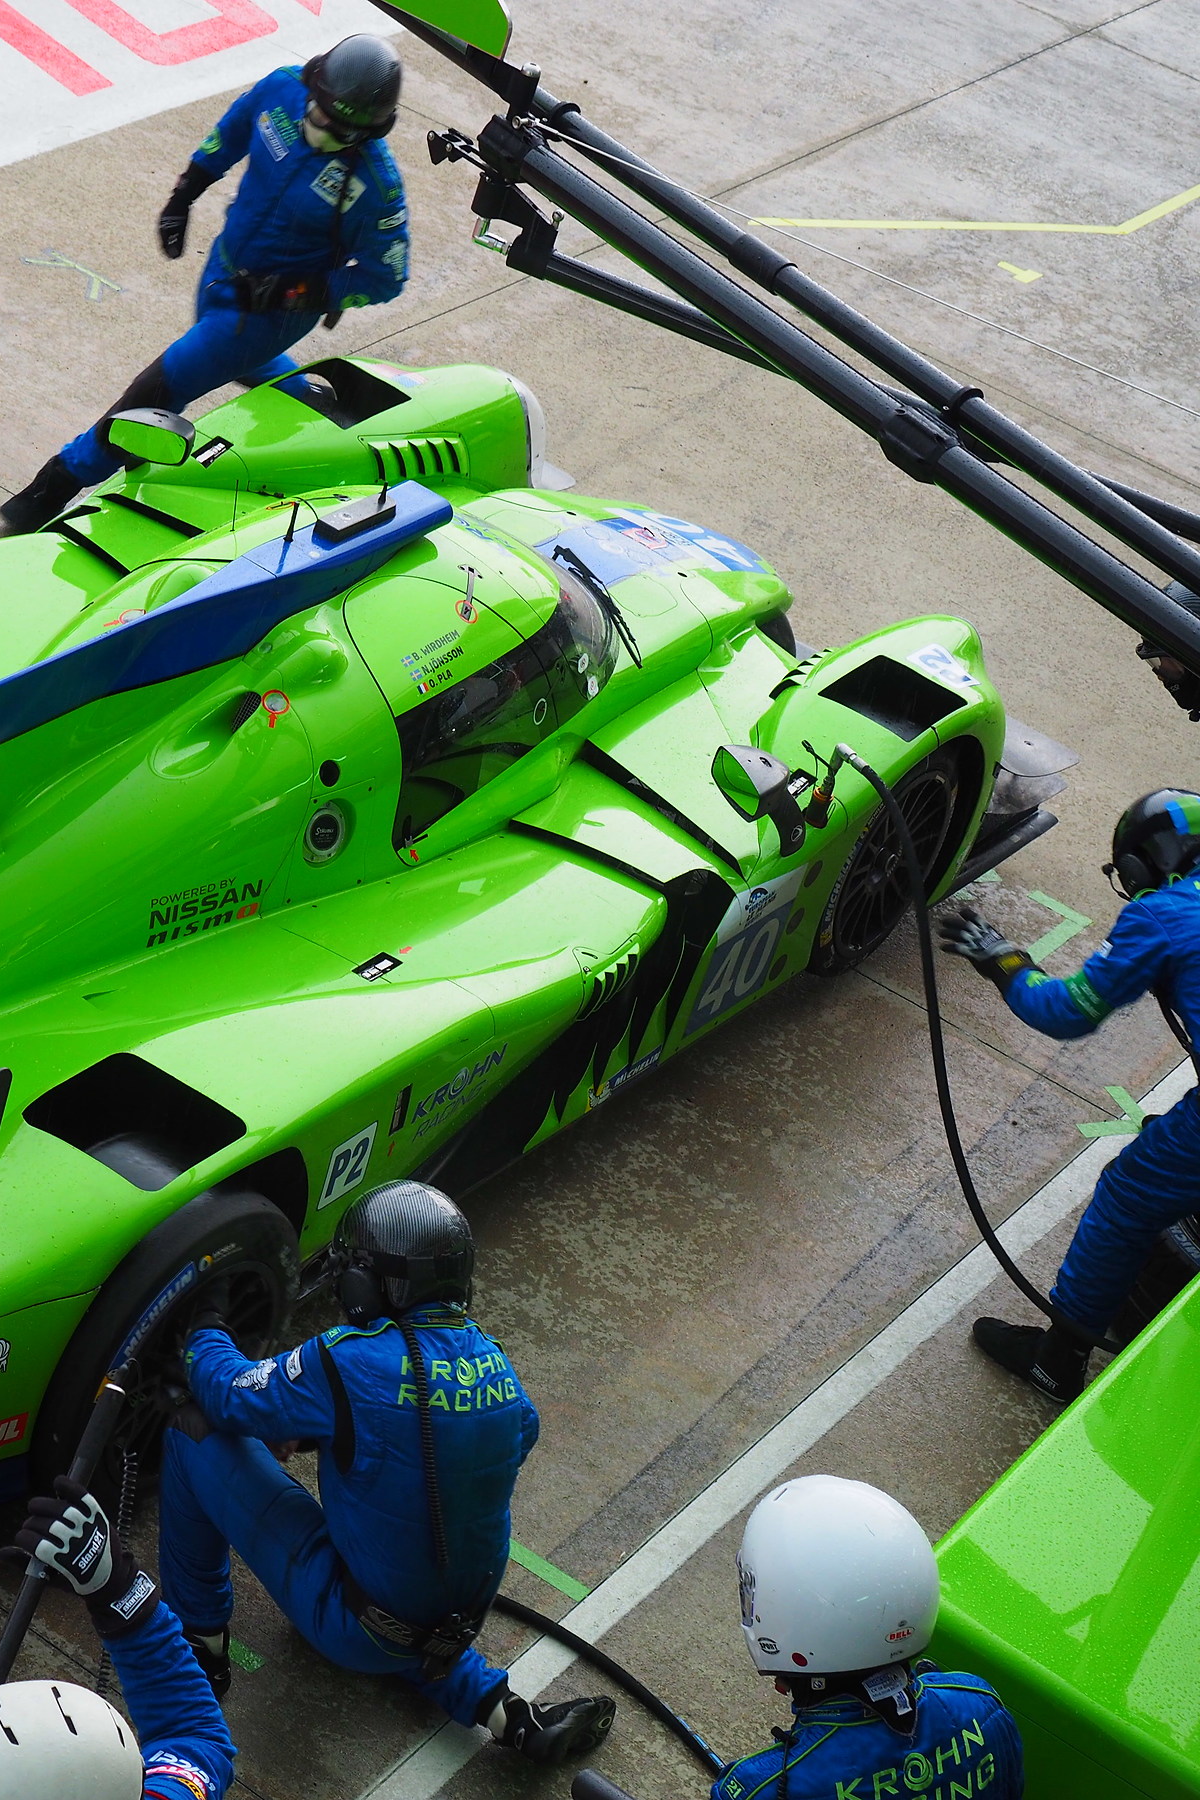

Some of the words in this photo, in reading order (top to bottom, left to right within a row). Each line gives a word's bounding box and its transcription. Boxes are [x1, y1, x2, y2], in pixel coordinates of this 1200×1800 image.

[642, 511, 755, 569] 40
[411, 652, 423, 661] B.
[420, 629, 461, 656] WIRDHEIM
[421, 645, 465, 676] N.JÖNSSON
[428, 678, 439, 688] O.
[437, 669, 454, 684] PLA
[148, 879, 263, 930] NISSAN
[150, 883, 216, 909] POWERED
[219, 877, 237, 890] BY
[698, 917, 780, 1016] 40
[410, 1043, 508, 1124] KROHN
[614, 1051, 661, 1087] MICHELIN
[411, 1079, 488, 1143] RACING
[324, 1136, 371, 1200] P2
[123, 1268, 194, 1357] MICHELIN
[401, 1352, 508, 1387] KROHN
[397, 1377, 518, 1413] RACING
[889, 1629, 912, 1642] BELL
[835, 1718, 986, 1800] KROHN
